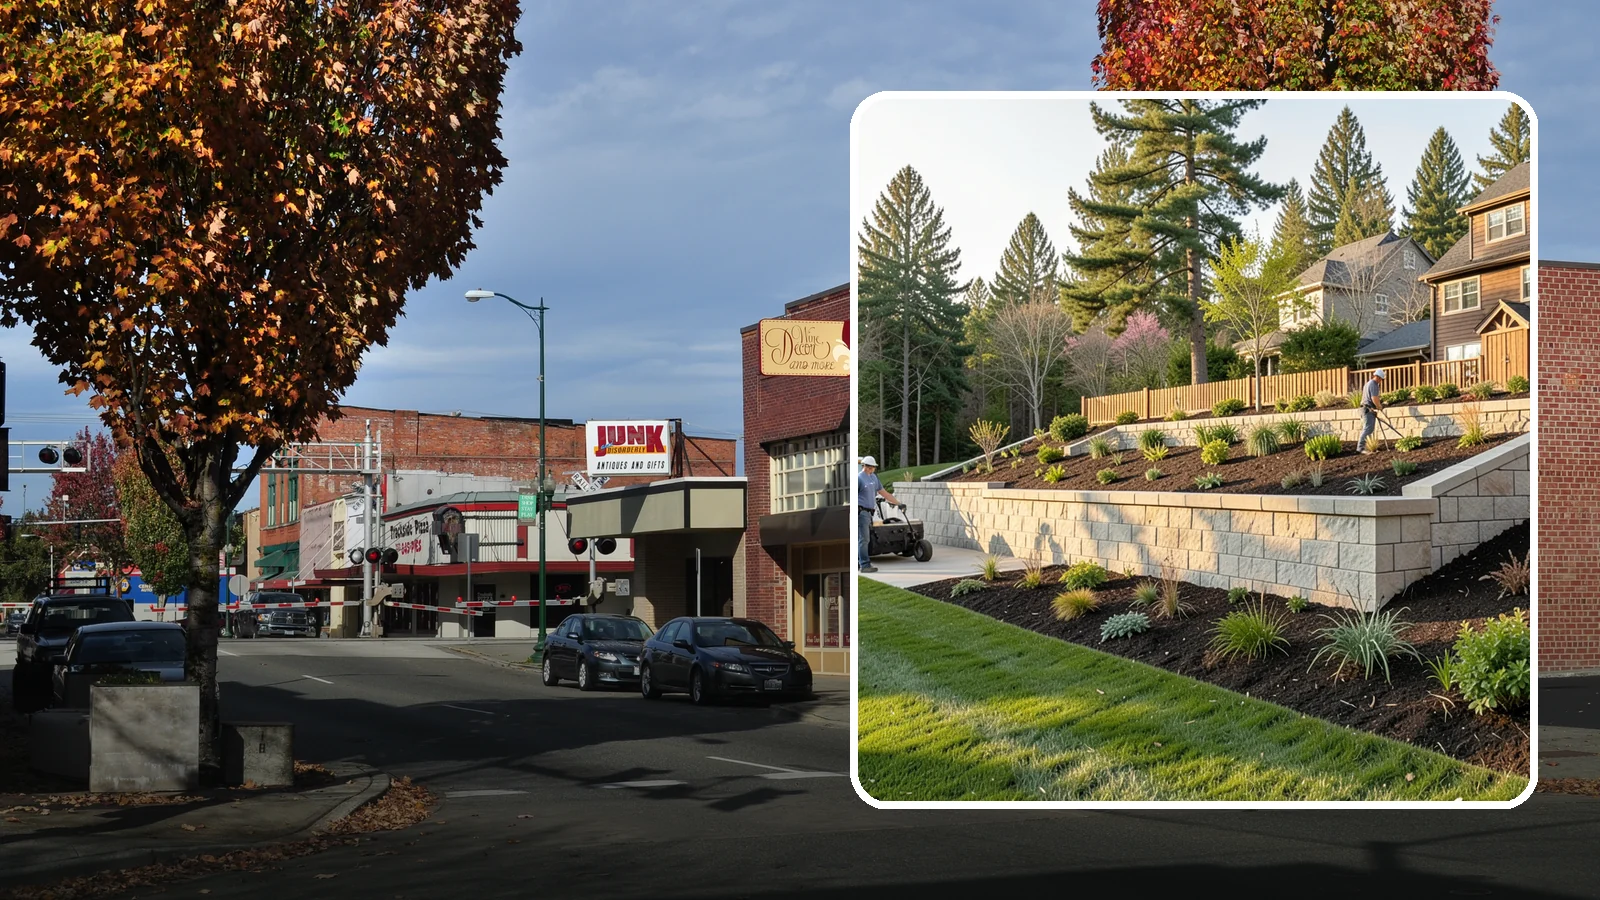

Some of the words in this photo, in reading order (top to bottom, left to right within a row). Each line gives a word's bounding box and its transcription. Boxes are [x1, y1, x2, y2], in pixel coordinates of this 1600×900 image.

[596, 425, 665, 457] JUNK
[597, 461, 628, 469] ANTIQUES
[631, 461, 643, 469] AND
[647, 460, 665, 469] GIFTS
[414, 520, 429, 535] Pizza
